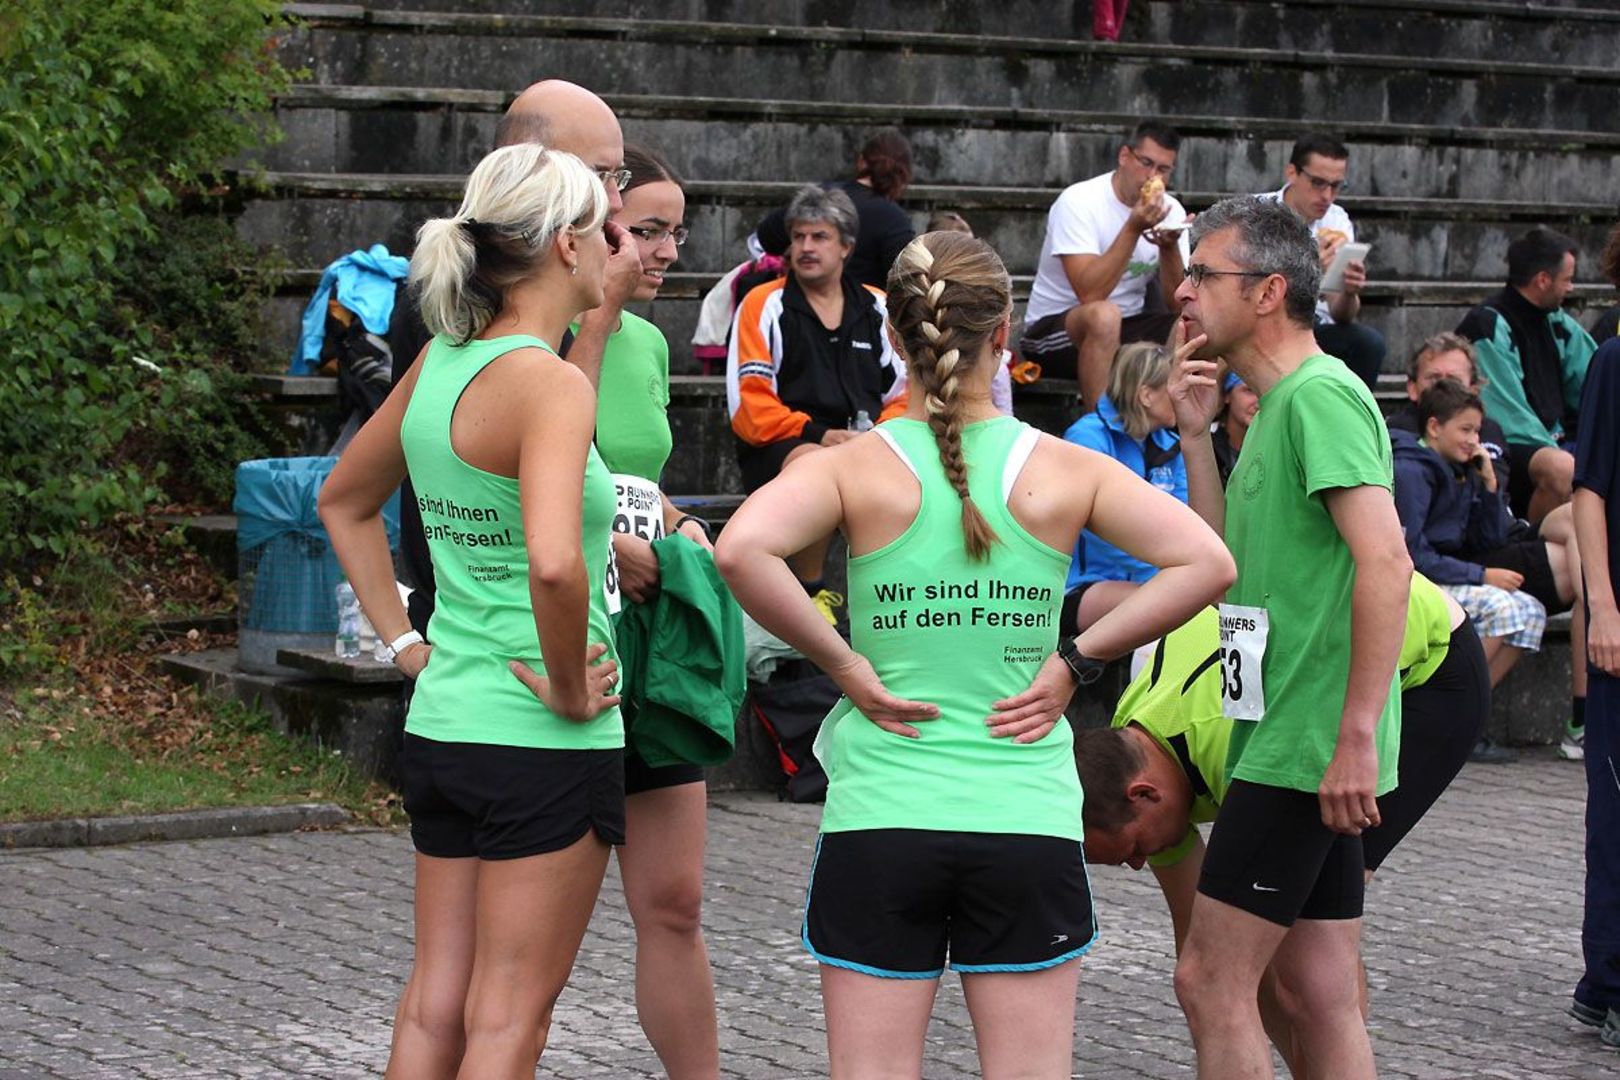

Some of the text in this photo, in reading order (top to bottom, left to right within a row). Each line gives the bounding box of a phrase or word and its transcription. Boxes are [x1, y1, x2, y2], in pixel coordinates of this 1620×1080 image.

[627, 485, 660, 505] RUNN
[419, 494, 499, 522] sind Ihnen
[627, 497, 653, 512] POINT
[468, 564, 510, 573] Finanzamt
[874, 579, 1051, 603] Wir sind Ihnen
[872, 607, 1052, 630] auf den Fersen!
[1004, 645, 1043, 654] Finanzamt
[1004, 654, 1042, 663] Hersbruck
